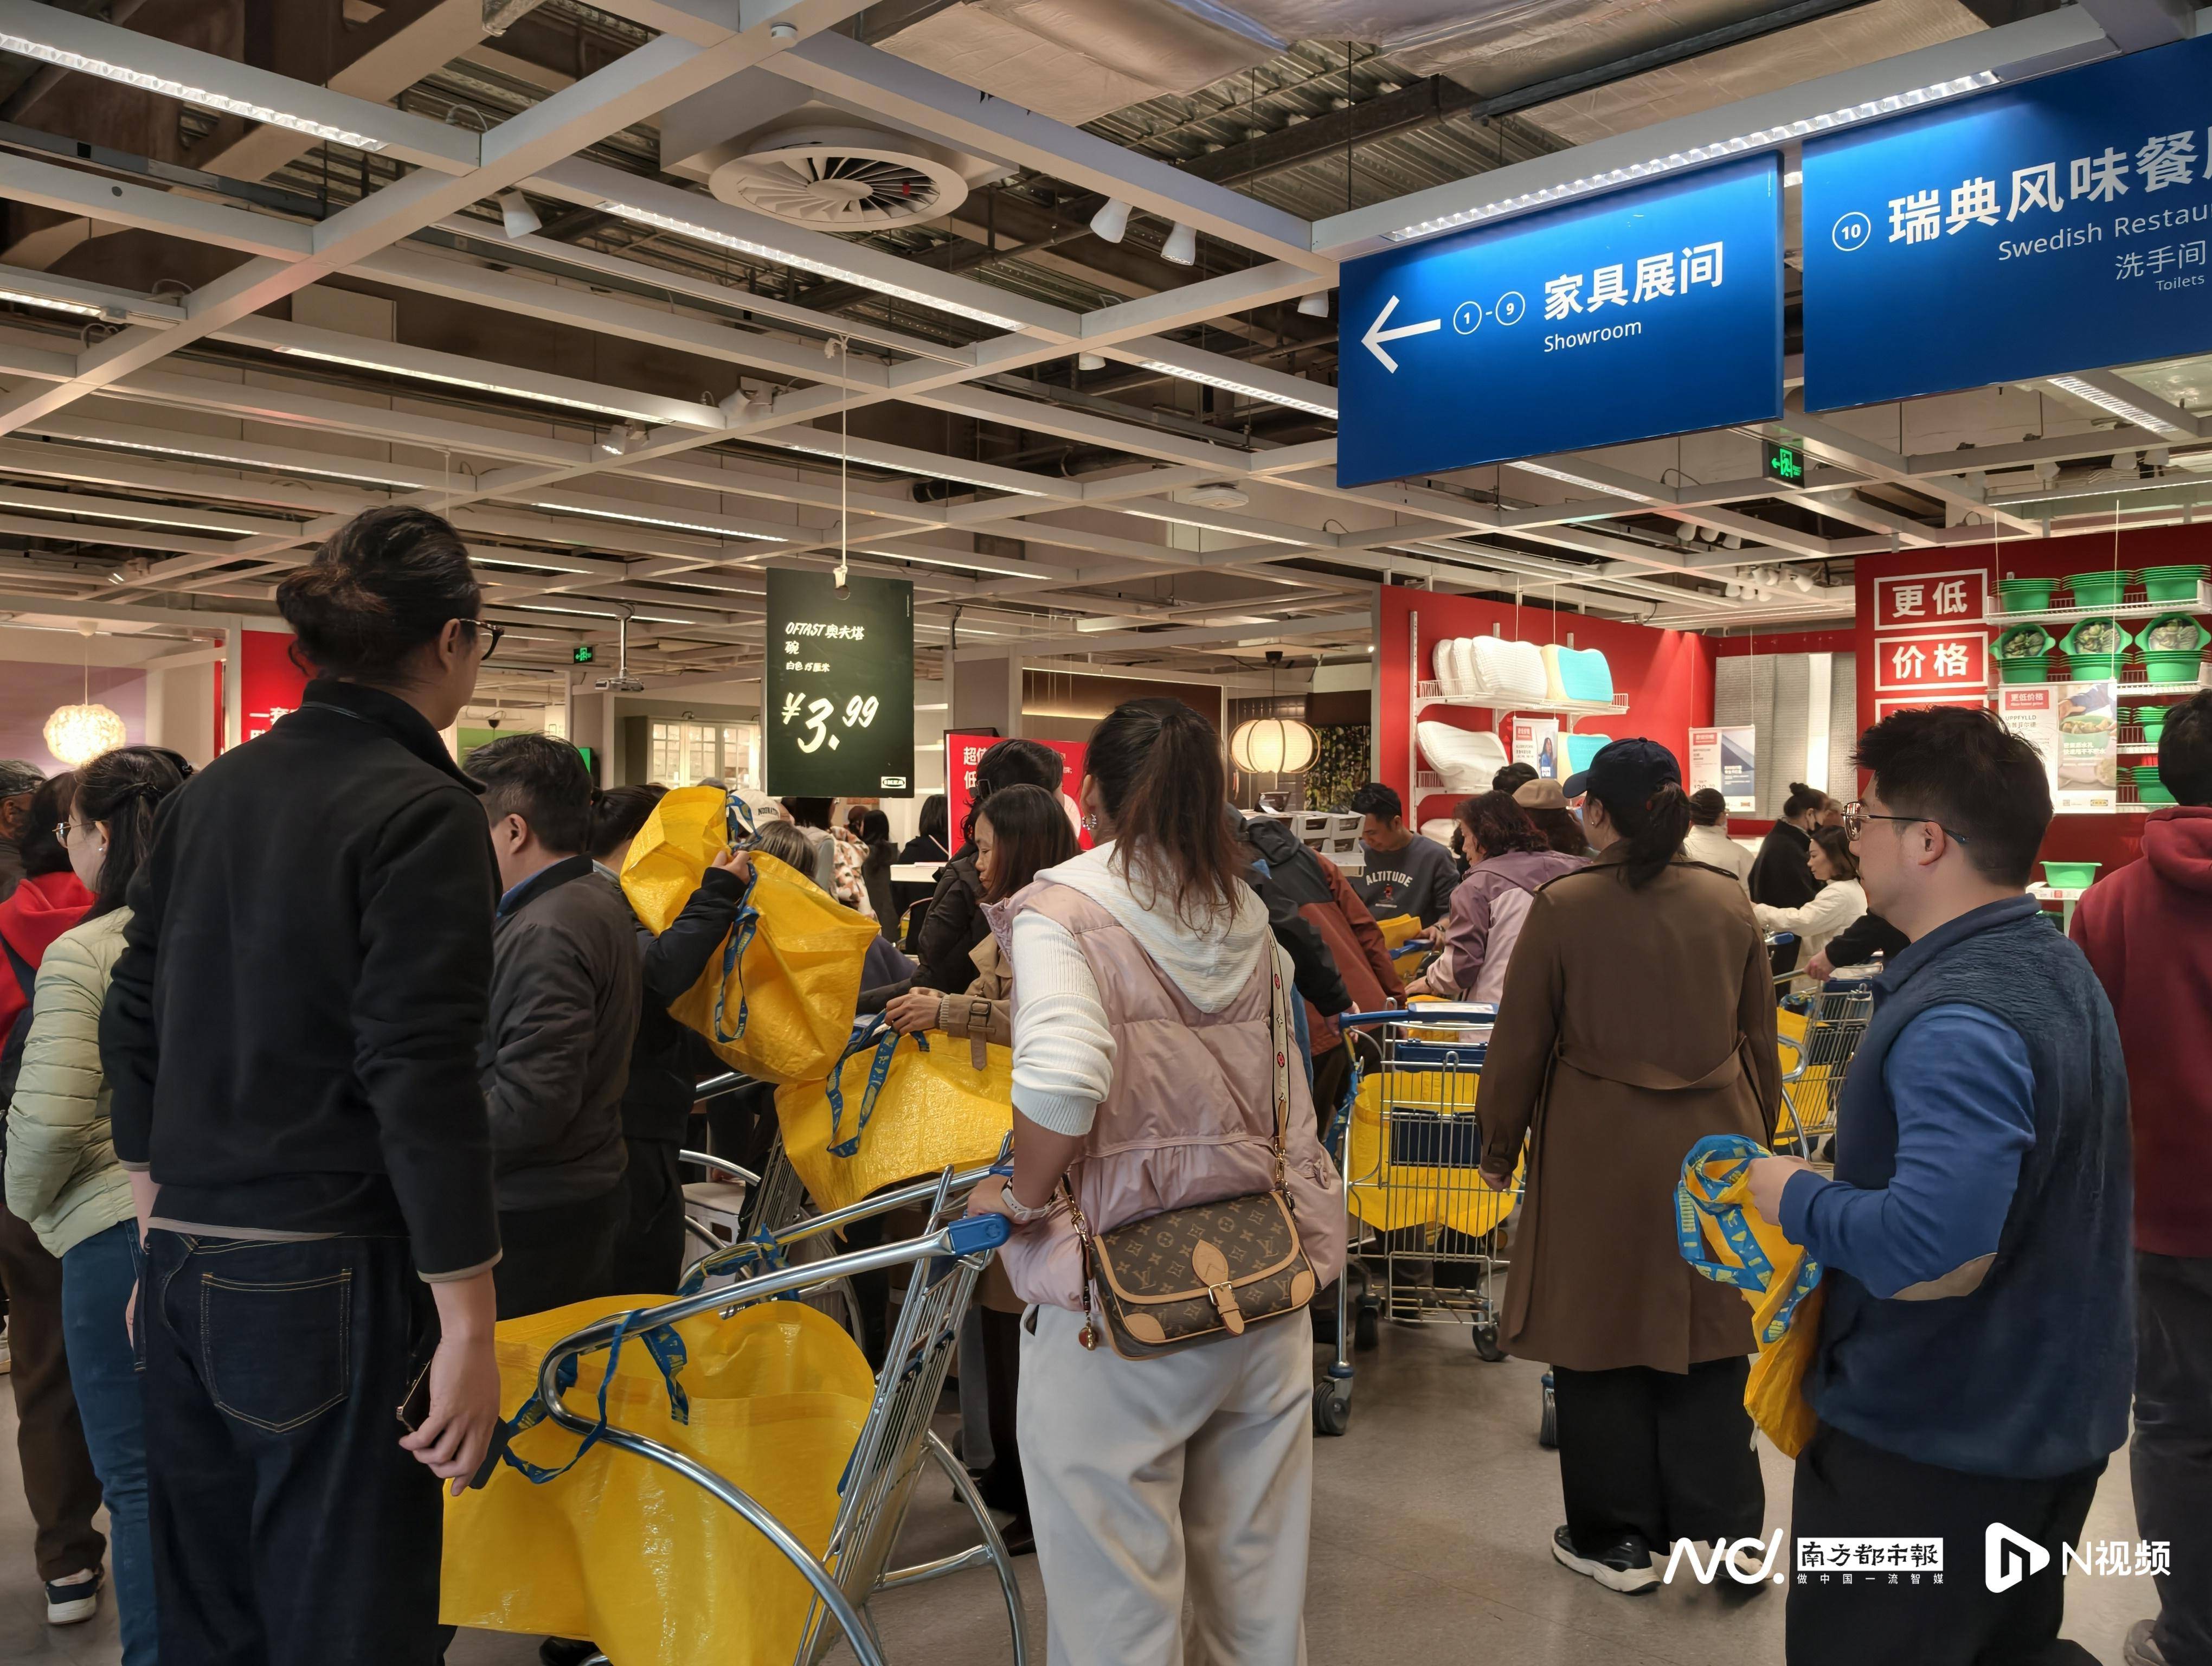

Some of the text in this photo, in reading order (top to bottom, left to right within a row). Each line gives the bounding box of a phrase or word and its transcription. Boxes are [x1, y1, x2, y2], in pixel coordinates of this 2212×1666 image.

[1888, 126, 2212, 245] 瑞典风味餐
[1998, 203, 2212, 261] Swedish Restau
[2115, 240, 2205, 280] 洗手间
[1544, 241, 1724, 321] 家具展间
[2155, 275, 2205, 291] Toilets
[1544, 321, 1642, 353] Showroom
[1892, 580, 1968, 618] 更低
[785, 622, 827, 637] OFTAST
[785, 640, 800, 655] 碗
[1892, 643, 1969, 678] 价格
[1366, 870, 1413, 887] ALTITUDE
